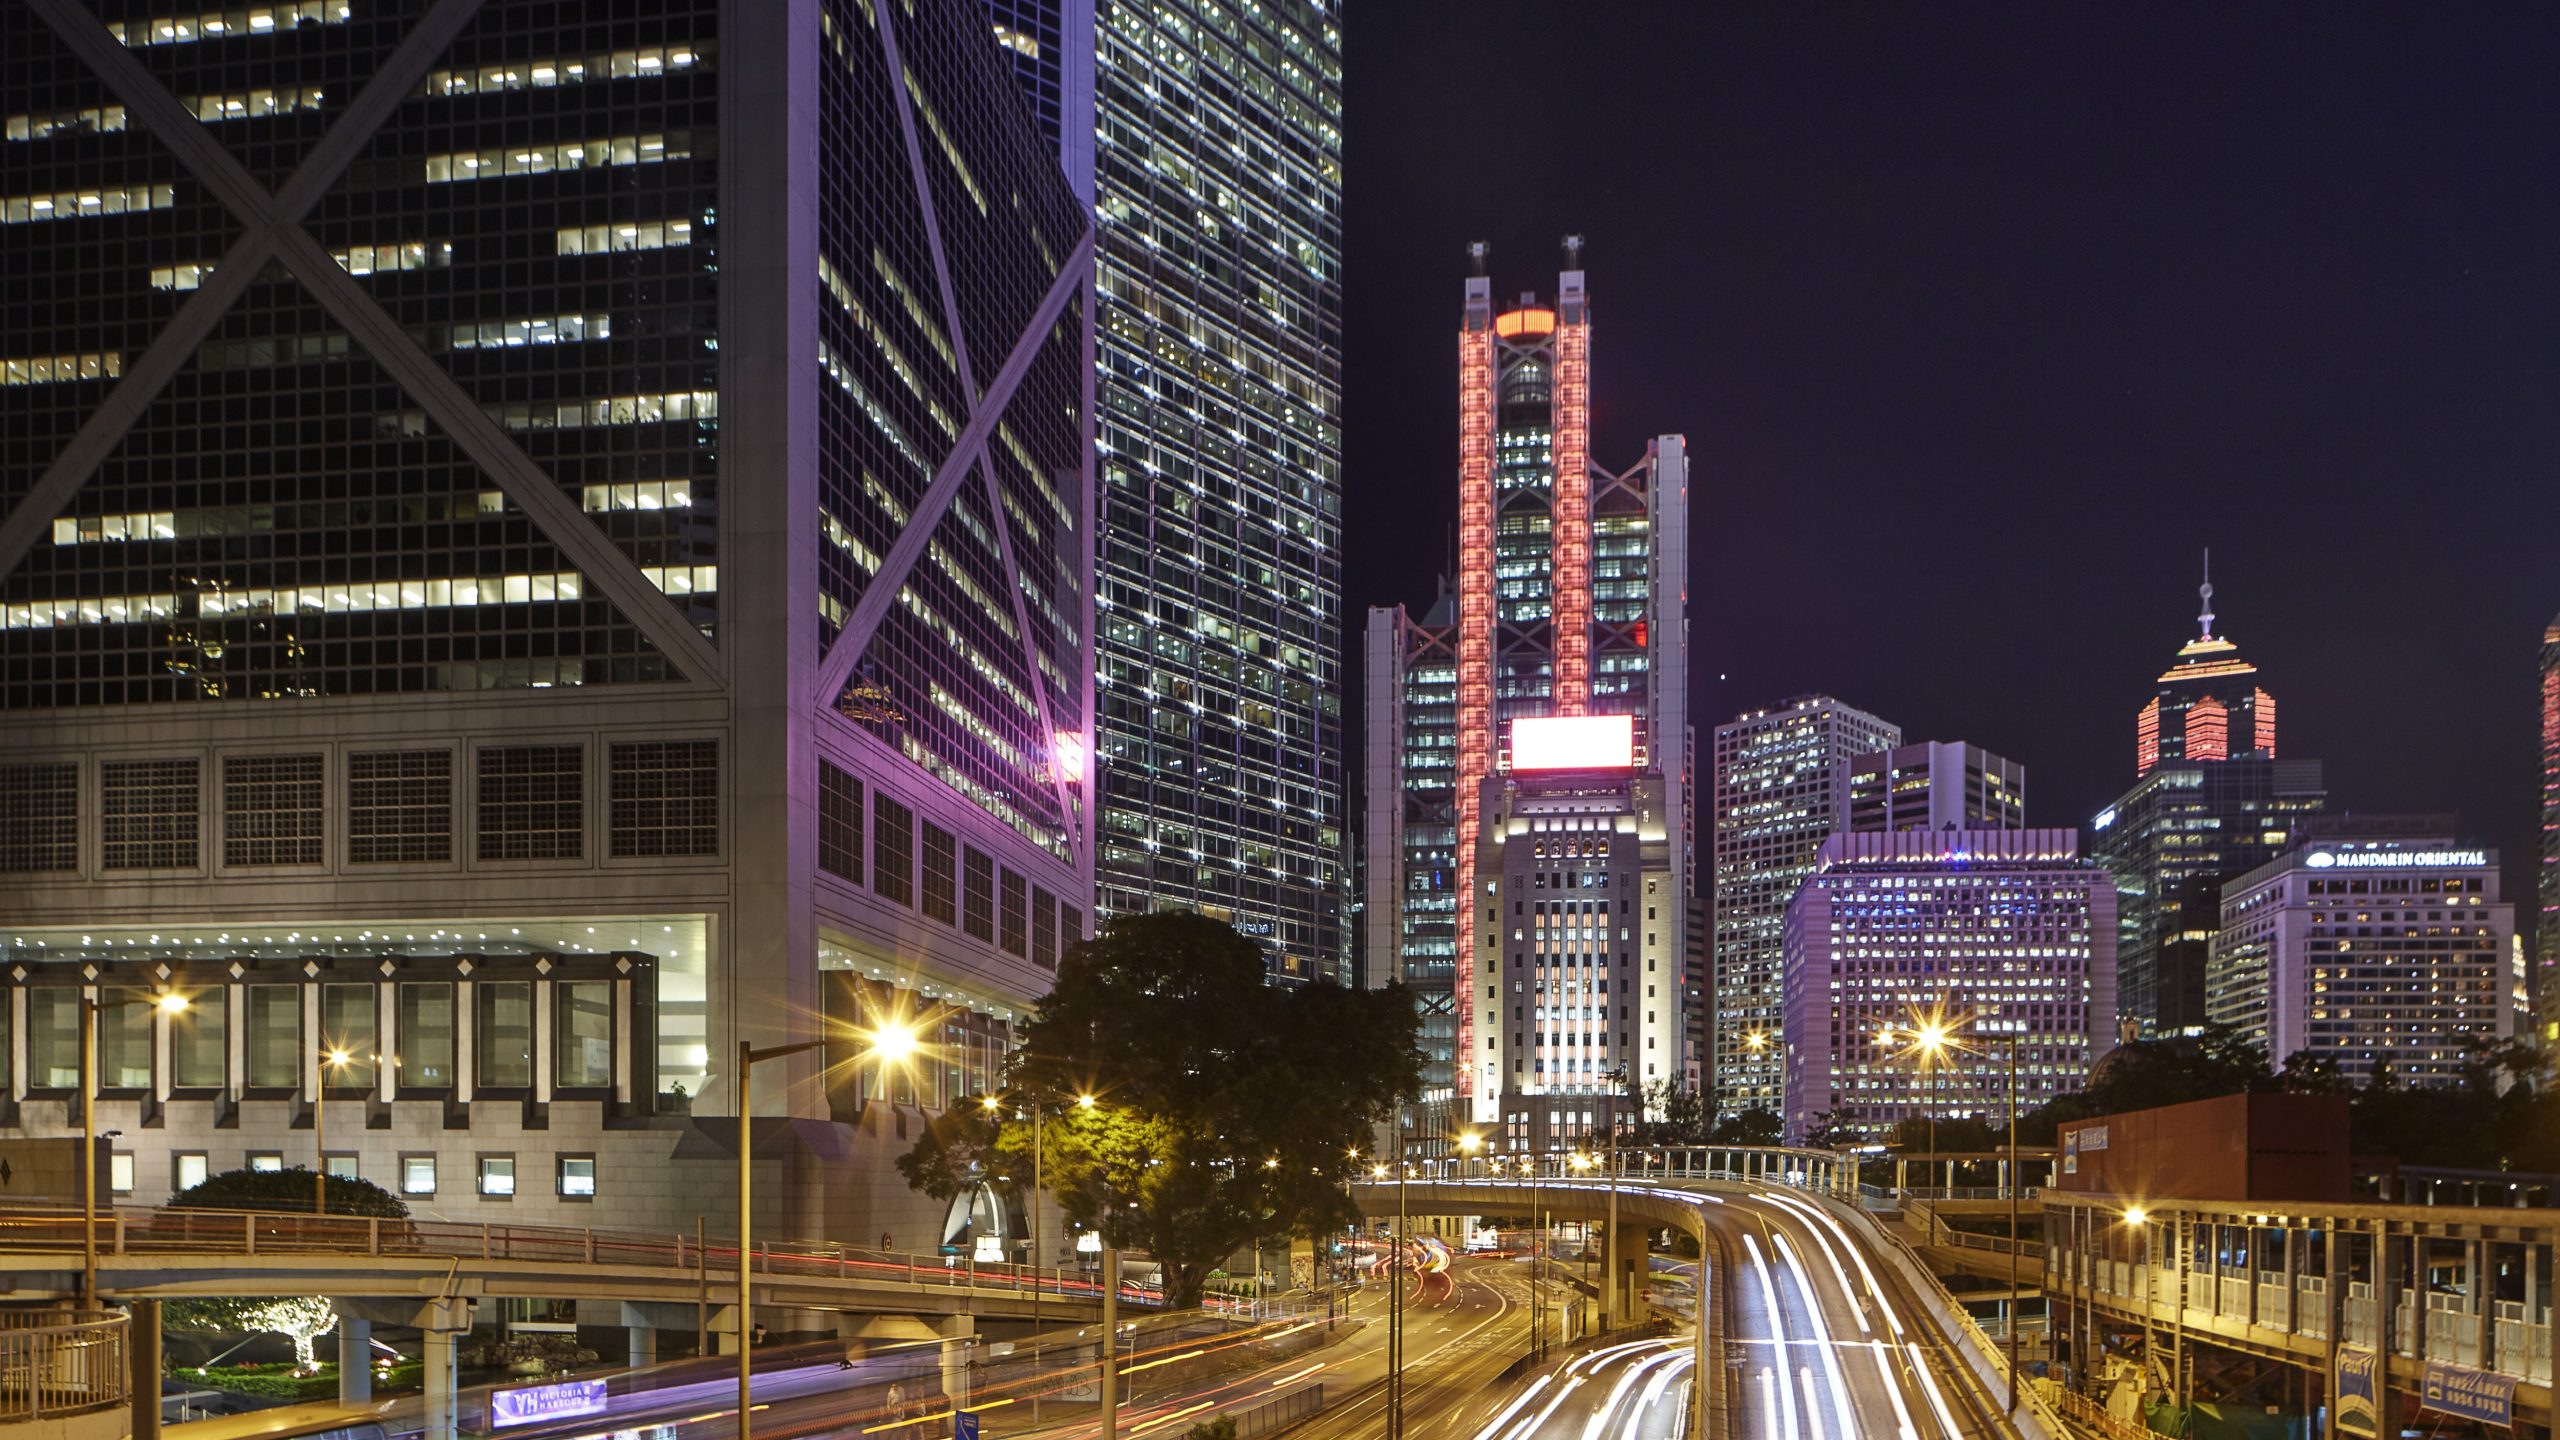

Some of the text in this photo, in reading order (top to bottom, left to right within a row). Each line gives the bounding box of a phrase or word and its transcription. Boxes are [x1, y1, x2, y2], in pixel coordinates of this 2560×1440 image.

[2337, 851, 2486, 867] MANDARIN ORIENTAL
[540, 1388, 582, 1401] VICTORIA
